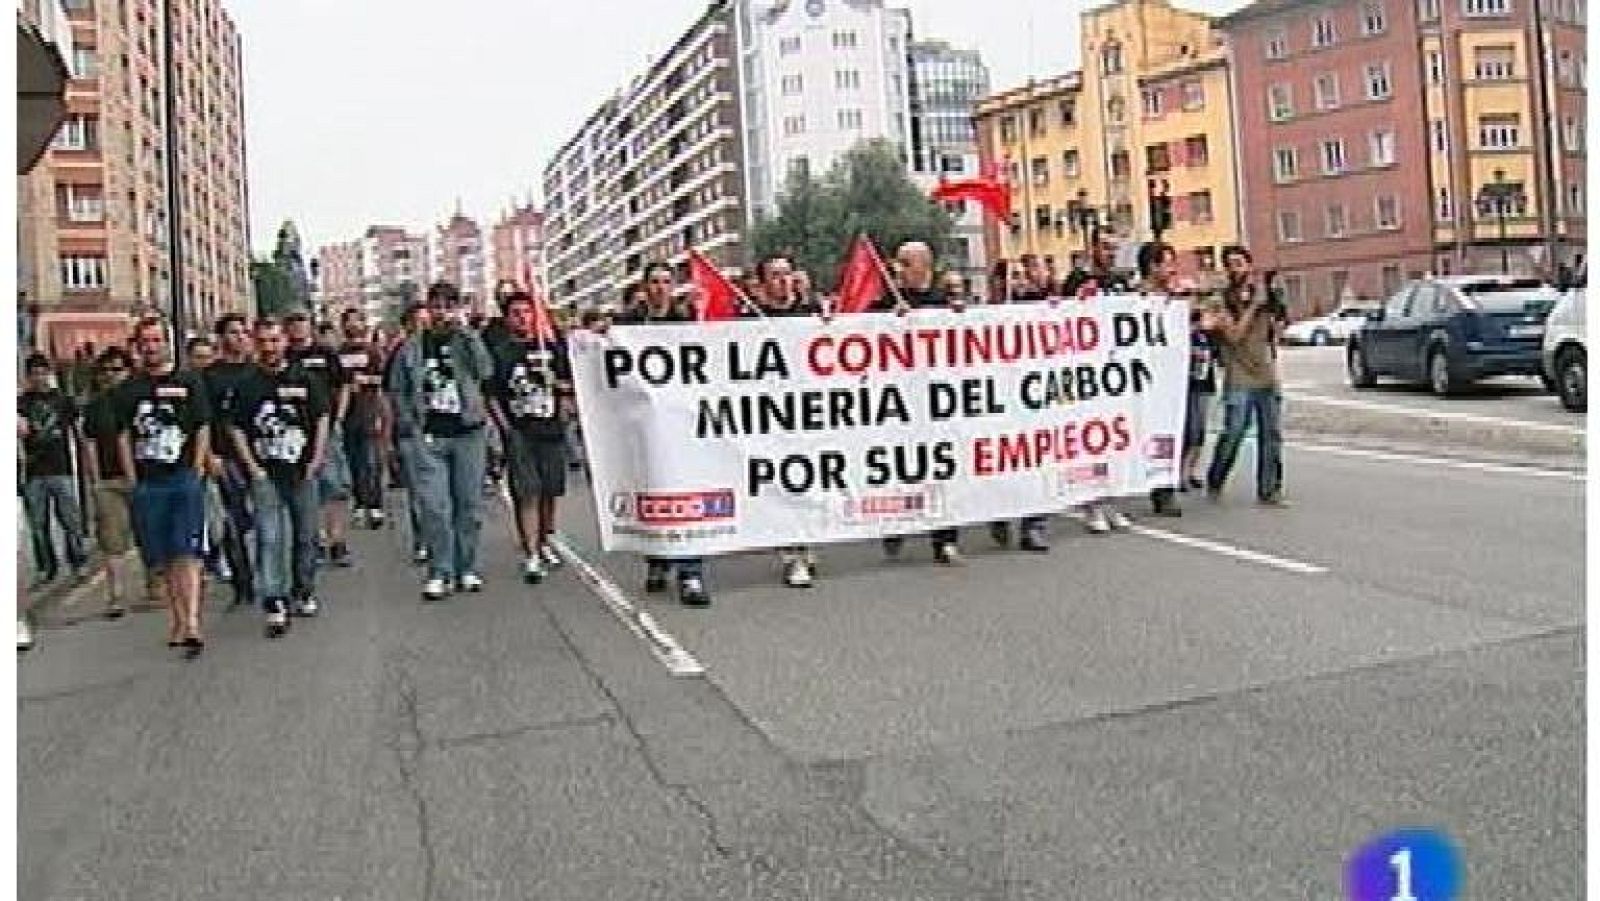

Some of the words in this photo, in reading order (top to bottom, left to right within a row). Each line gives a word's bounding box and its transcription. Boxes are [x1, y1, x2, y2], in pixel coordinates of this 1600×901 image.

[604, 344, 707, 388] POR
[728, 338, 790, 381] LA
[807, 317, 1100, 376] CONTINUIDAD
[696, 375, 910, 438] MINERÍA
[929, 375, 1005, 422] DEL
[1020, 350, 1152, 410] CARBÓN
[748, 451, 847, 497] POR
[865, 442, 957, 486] SUS
[973, 417, 1131, 476] EMPLEOS
